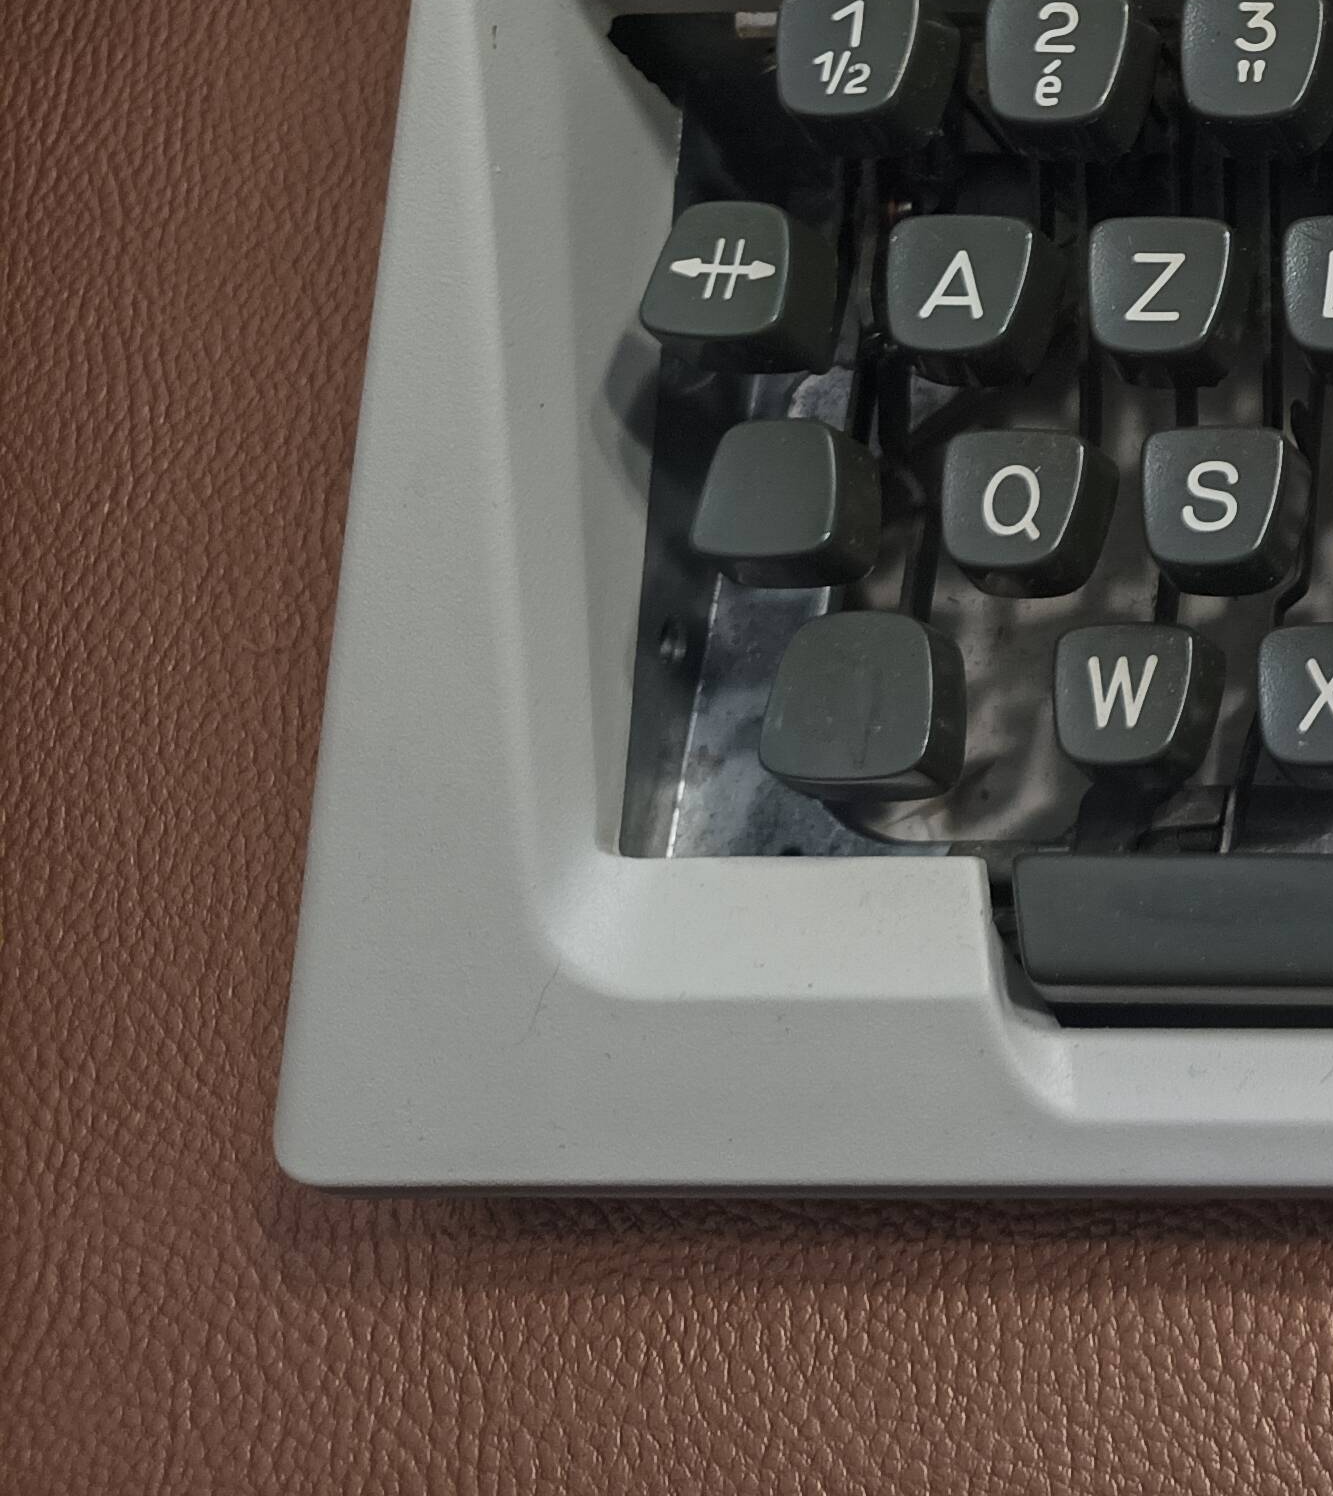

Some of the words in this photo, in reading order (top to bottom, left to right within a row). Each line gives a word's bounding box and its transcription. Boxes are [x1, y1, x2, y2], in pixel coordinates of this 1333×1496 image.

[830, 0, 866, 48] 1
[1034, 1, 1079, 53] 2
[1235, 1, 1276, 52] 3
[1034, 59, 1062, 107] é
[919, 250, 984, 319] A
[1125, 252, 1186, 321] Z
[983, 464, 1040, 540] Q
[1182, 460, 1239, 532] S
[1088, 654, 1158, 728] W
